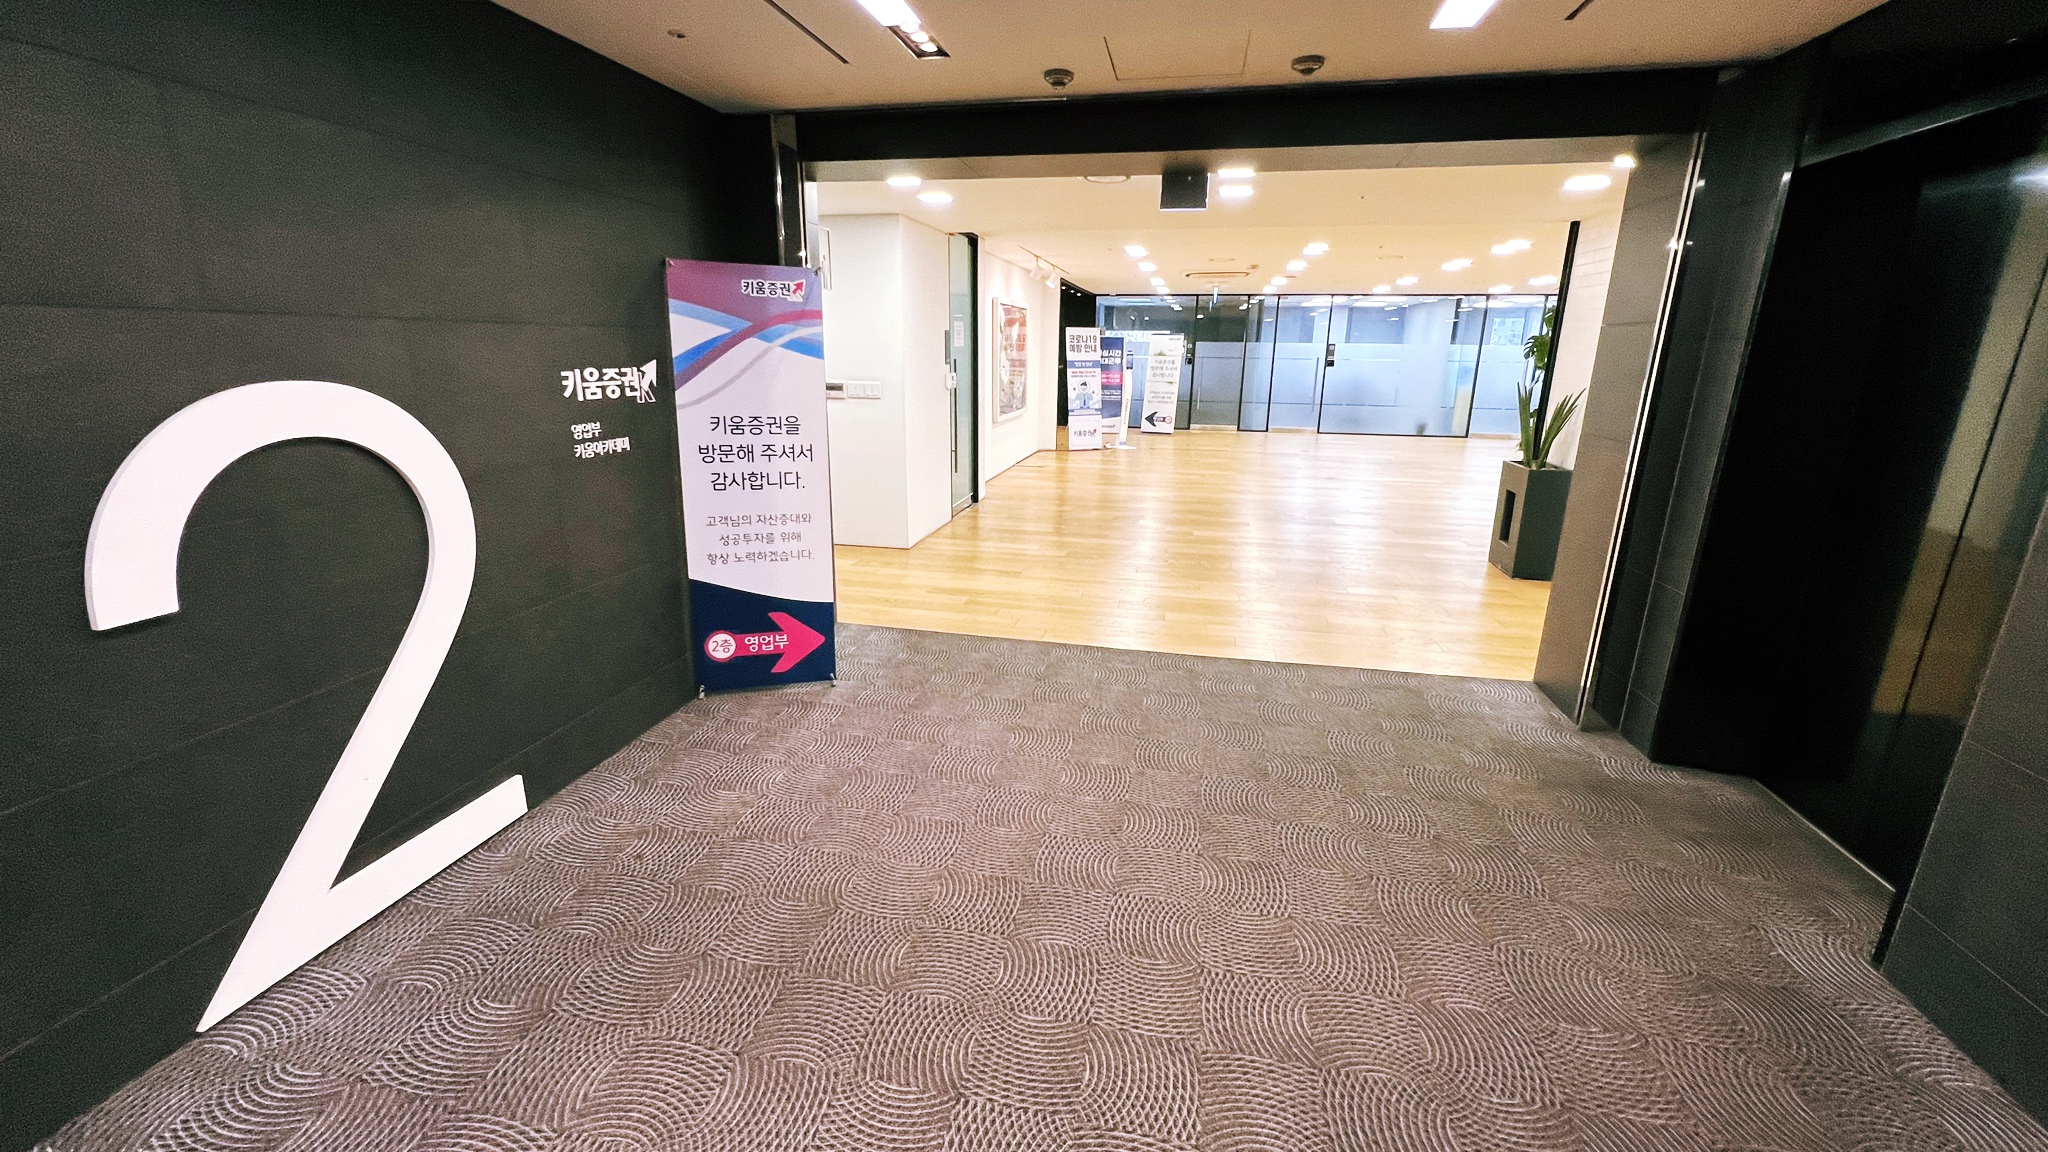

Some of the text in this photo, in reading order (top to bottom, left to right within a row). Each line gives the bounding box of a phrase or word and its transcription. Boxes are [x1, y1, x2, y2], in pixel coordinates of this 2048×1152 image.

[742, 280, 792, 297] 키움증권
[1068, 334, 1098, 344] 코로나19
[1084, 344, 1098, 353] 안내
[560, 366, 641, 402] 키움증권
[570, 421, 602, 440] 영업부
[709, 415, 802, 436] 키움증권을
[573, 436, 631, 459] 키움아카데미
[698, 443, 814, 464] 방문해 주셔서
[710, 471, 806, 491] 감사합니다.
[705, 513, 812, 528] 고객님의 자산증대와
[719, 531, 802, 547] 성공투자를 위해
[706, 549, 815, 566] 항상 노력하겠습니다.
[711, 633, 790, 654] 2층 영업부
[84, 380, 528, 1032] 2
